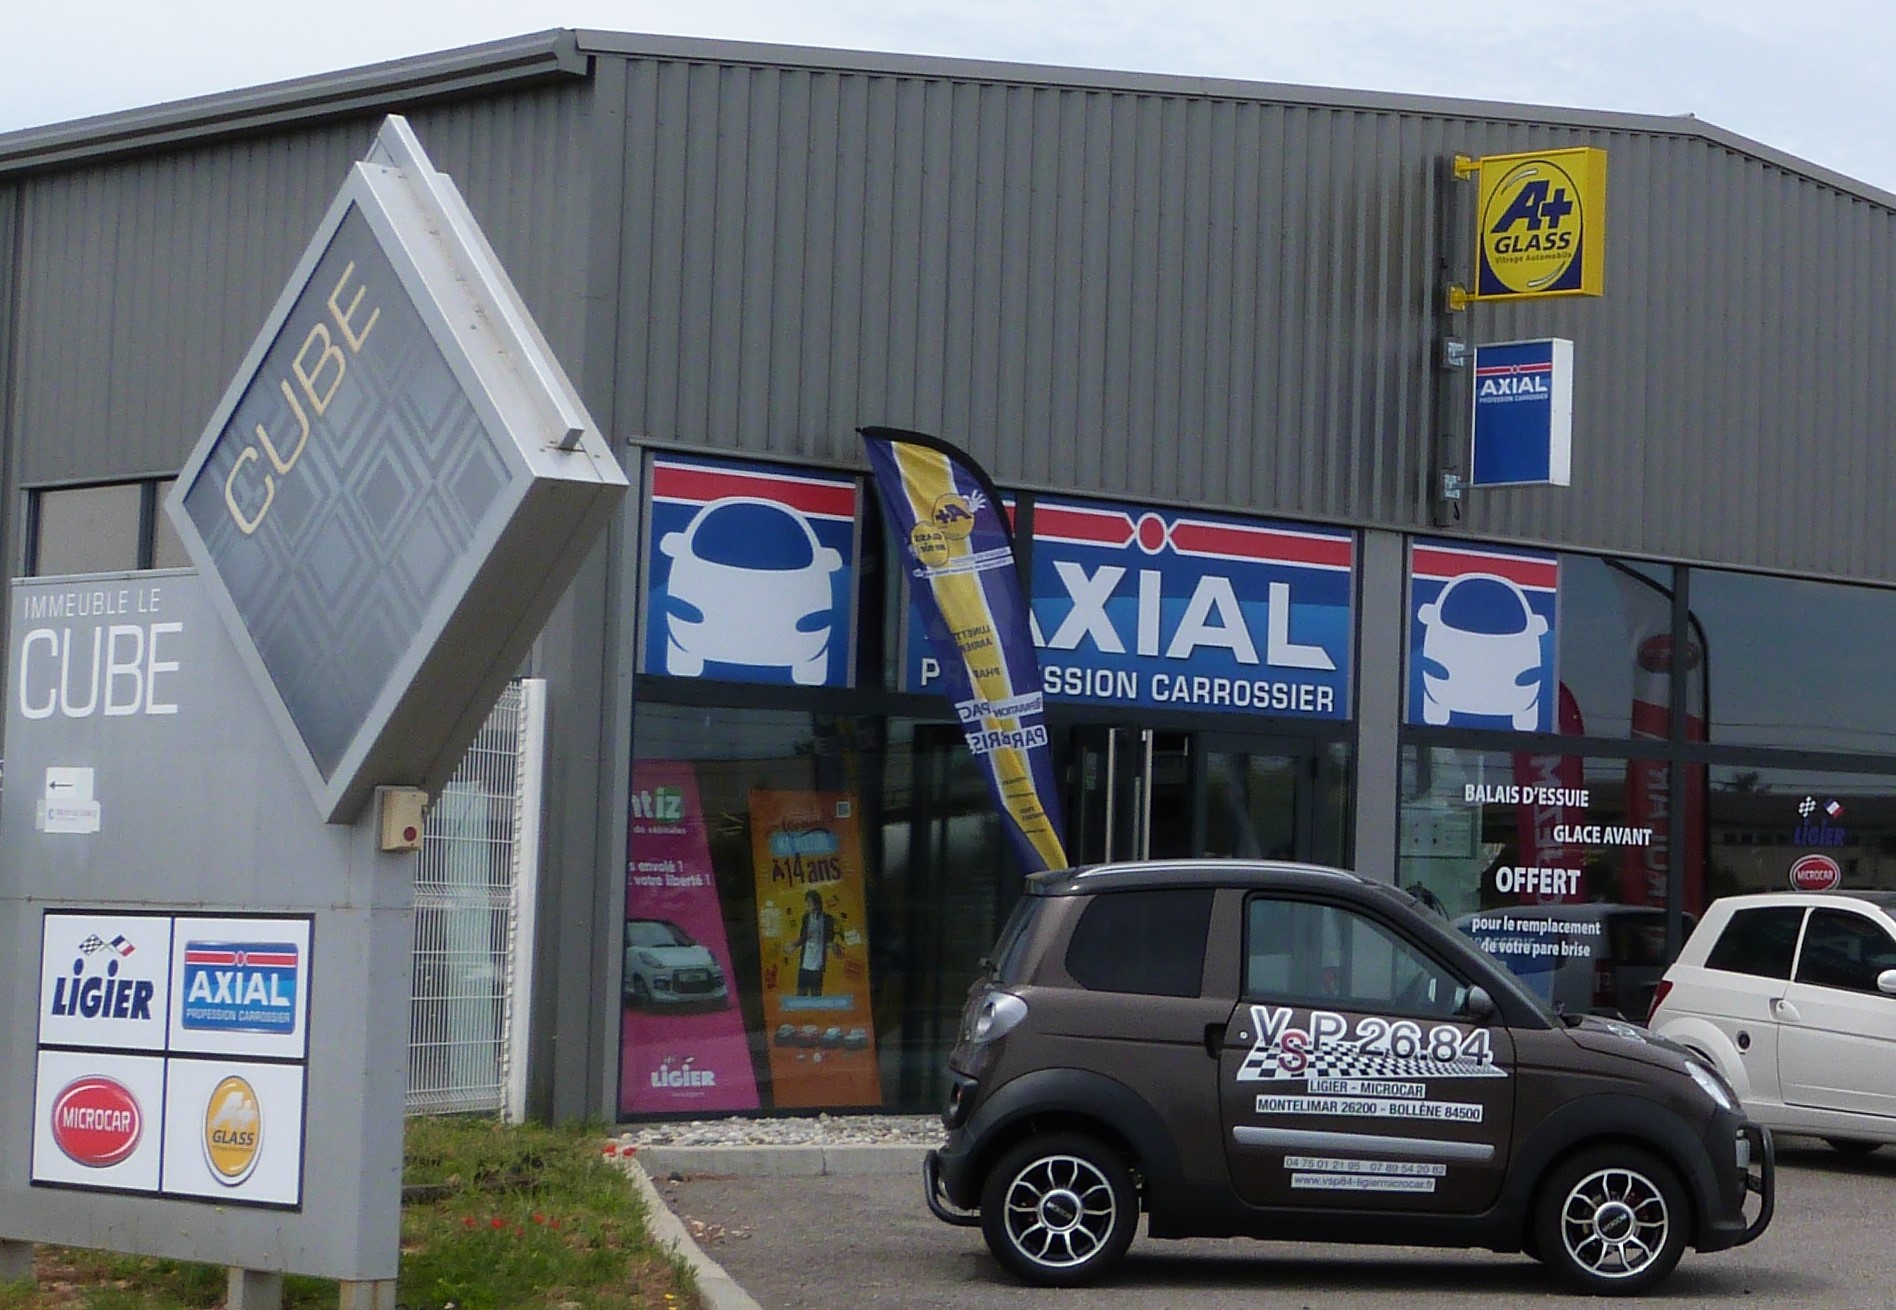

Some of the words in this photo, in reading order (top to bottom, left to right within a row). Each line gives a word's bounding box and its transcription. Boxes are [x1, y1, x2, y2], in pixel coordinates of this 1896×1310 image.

[1491, 180, 1573, 233] A+
[1494, 231, 1571, 254] GLASS
[225, 261, 381, 535] CUBE
[1480, 376, 1548, 396] AXIAL
[25, 590, 129, 619] IMMEUBLE
[138, 588, 161, 613] LE
[1030, 561, 1336, 671] XIAL
[19, 622, 183, 720] CUBE
[921, 658, 1138, 699] PSSION
[1151, 673, 1334, 713] CARROSSIER
[1465, 783, 1520, 804] BALAIS
[1523, 787, 1589, 808] D'ESSUIE
[1553, 824, 1601, 844] GLACE
[1603, 826, 1652, 846] AVANT
[1495, 866, 1581, 895] OFFERT
[1472, 916, 1502, 933] pour
[1504, 915, 1515, 931] le
[1516, 917, 1601, 937] remplacement
[1481, 938, 1497, 953] de
[1498, 940, 1531, 955] votre
[1532, 942, 1560, 959] pare
[1561, 940, 1591, 957] brise
[51, 957, 154, 1020] LIGIER
[188, 970, 291, 1006] AXIAL
[1309, 1080, 1348, 1093] LIGIER
[1360, 1082, 1423, 1097] MICROCAR
[63, 1107, 131, 1133] MICROCAR
[1257, 1099, 1338, 1113] MONTELIMAR
[1341, 1102, 1377, 1115] 26200
[1389, 1102, 1442, 1118] BOLLÈNE
[1444, 1106, 1480, 1120] 84500
[212, 1129, 255, 1146] GLASS
[1302, 1160, 1314, 1168] 75
[1370, 1163, 1382, 1171] 07
[1401, 1164, 1413, 1173] 54
